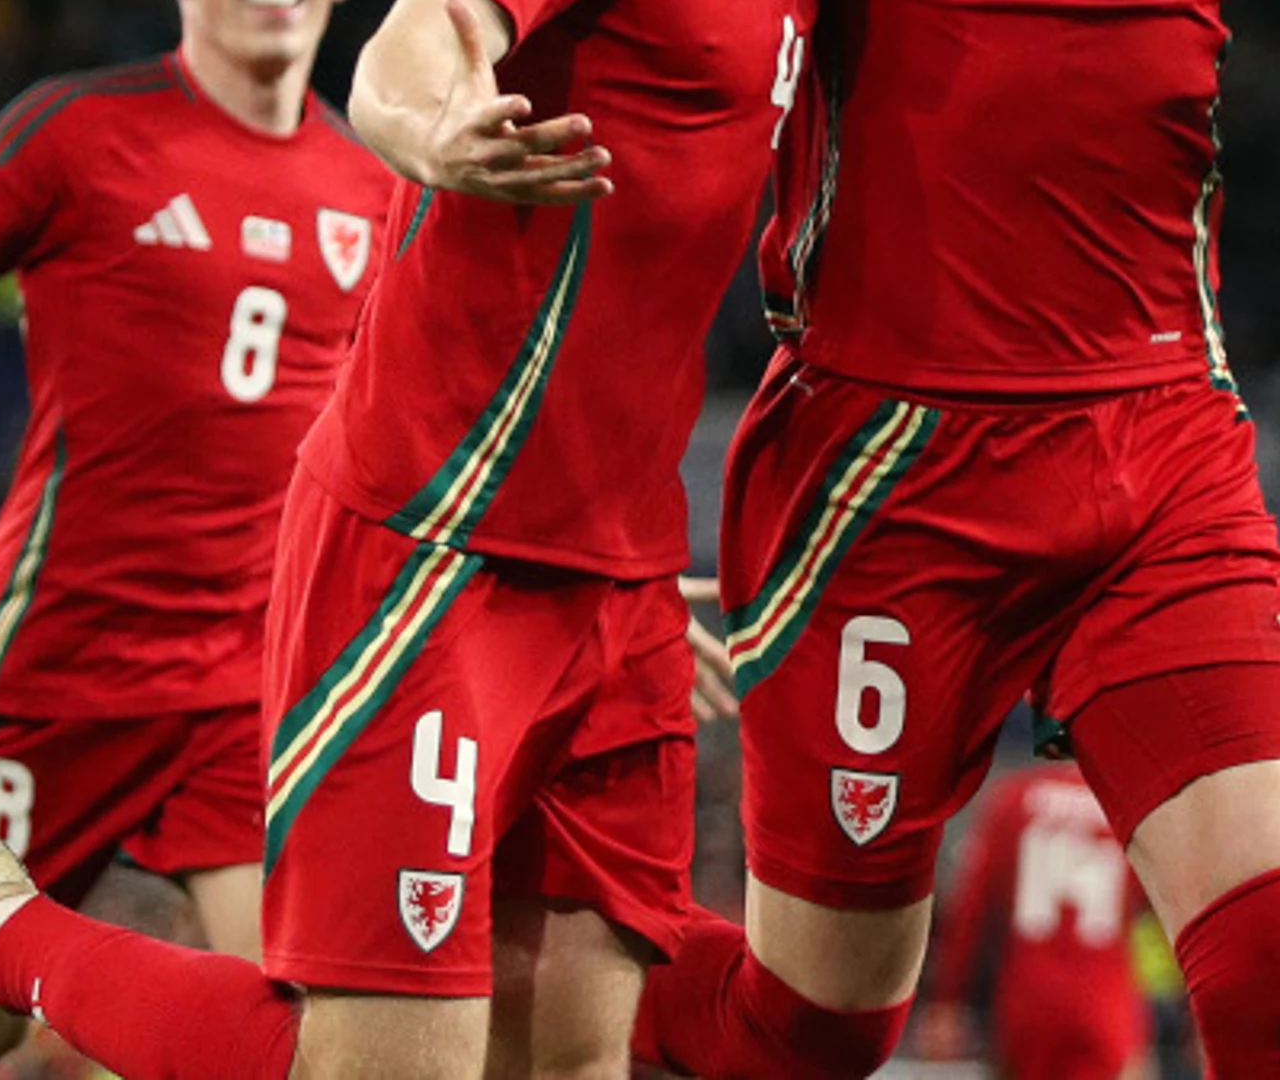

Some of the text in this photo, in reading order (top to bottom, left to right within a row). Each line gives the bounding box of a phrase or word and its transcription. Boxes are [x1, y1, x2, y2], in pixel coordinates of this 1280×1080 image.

[771, 15, 804, 150] 4
[221, 285, 287, 403] 8
[835, 615, 910, 754] 6
[410, 710, 478, 857] 4
